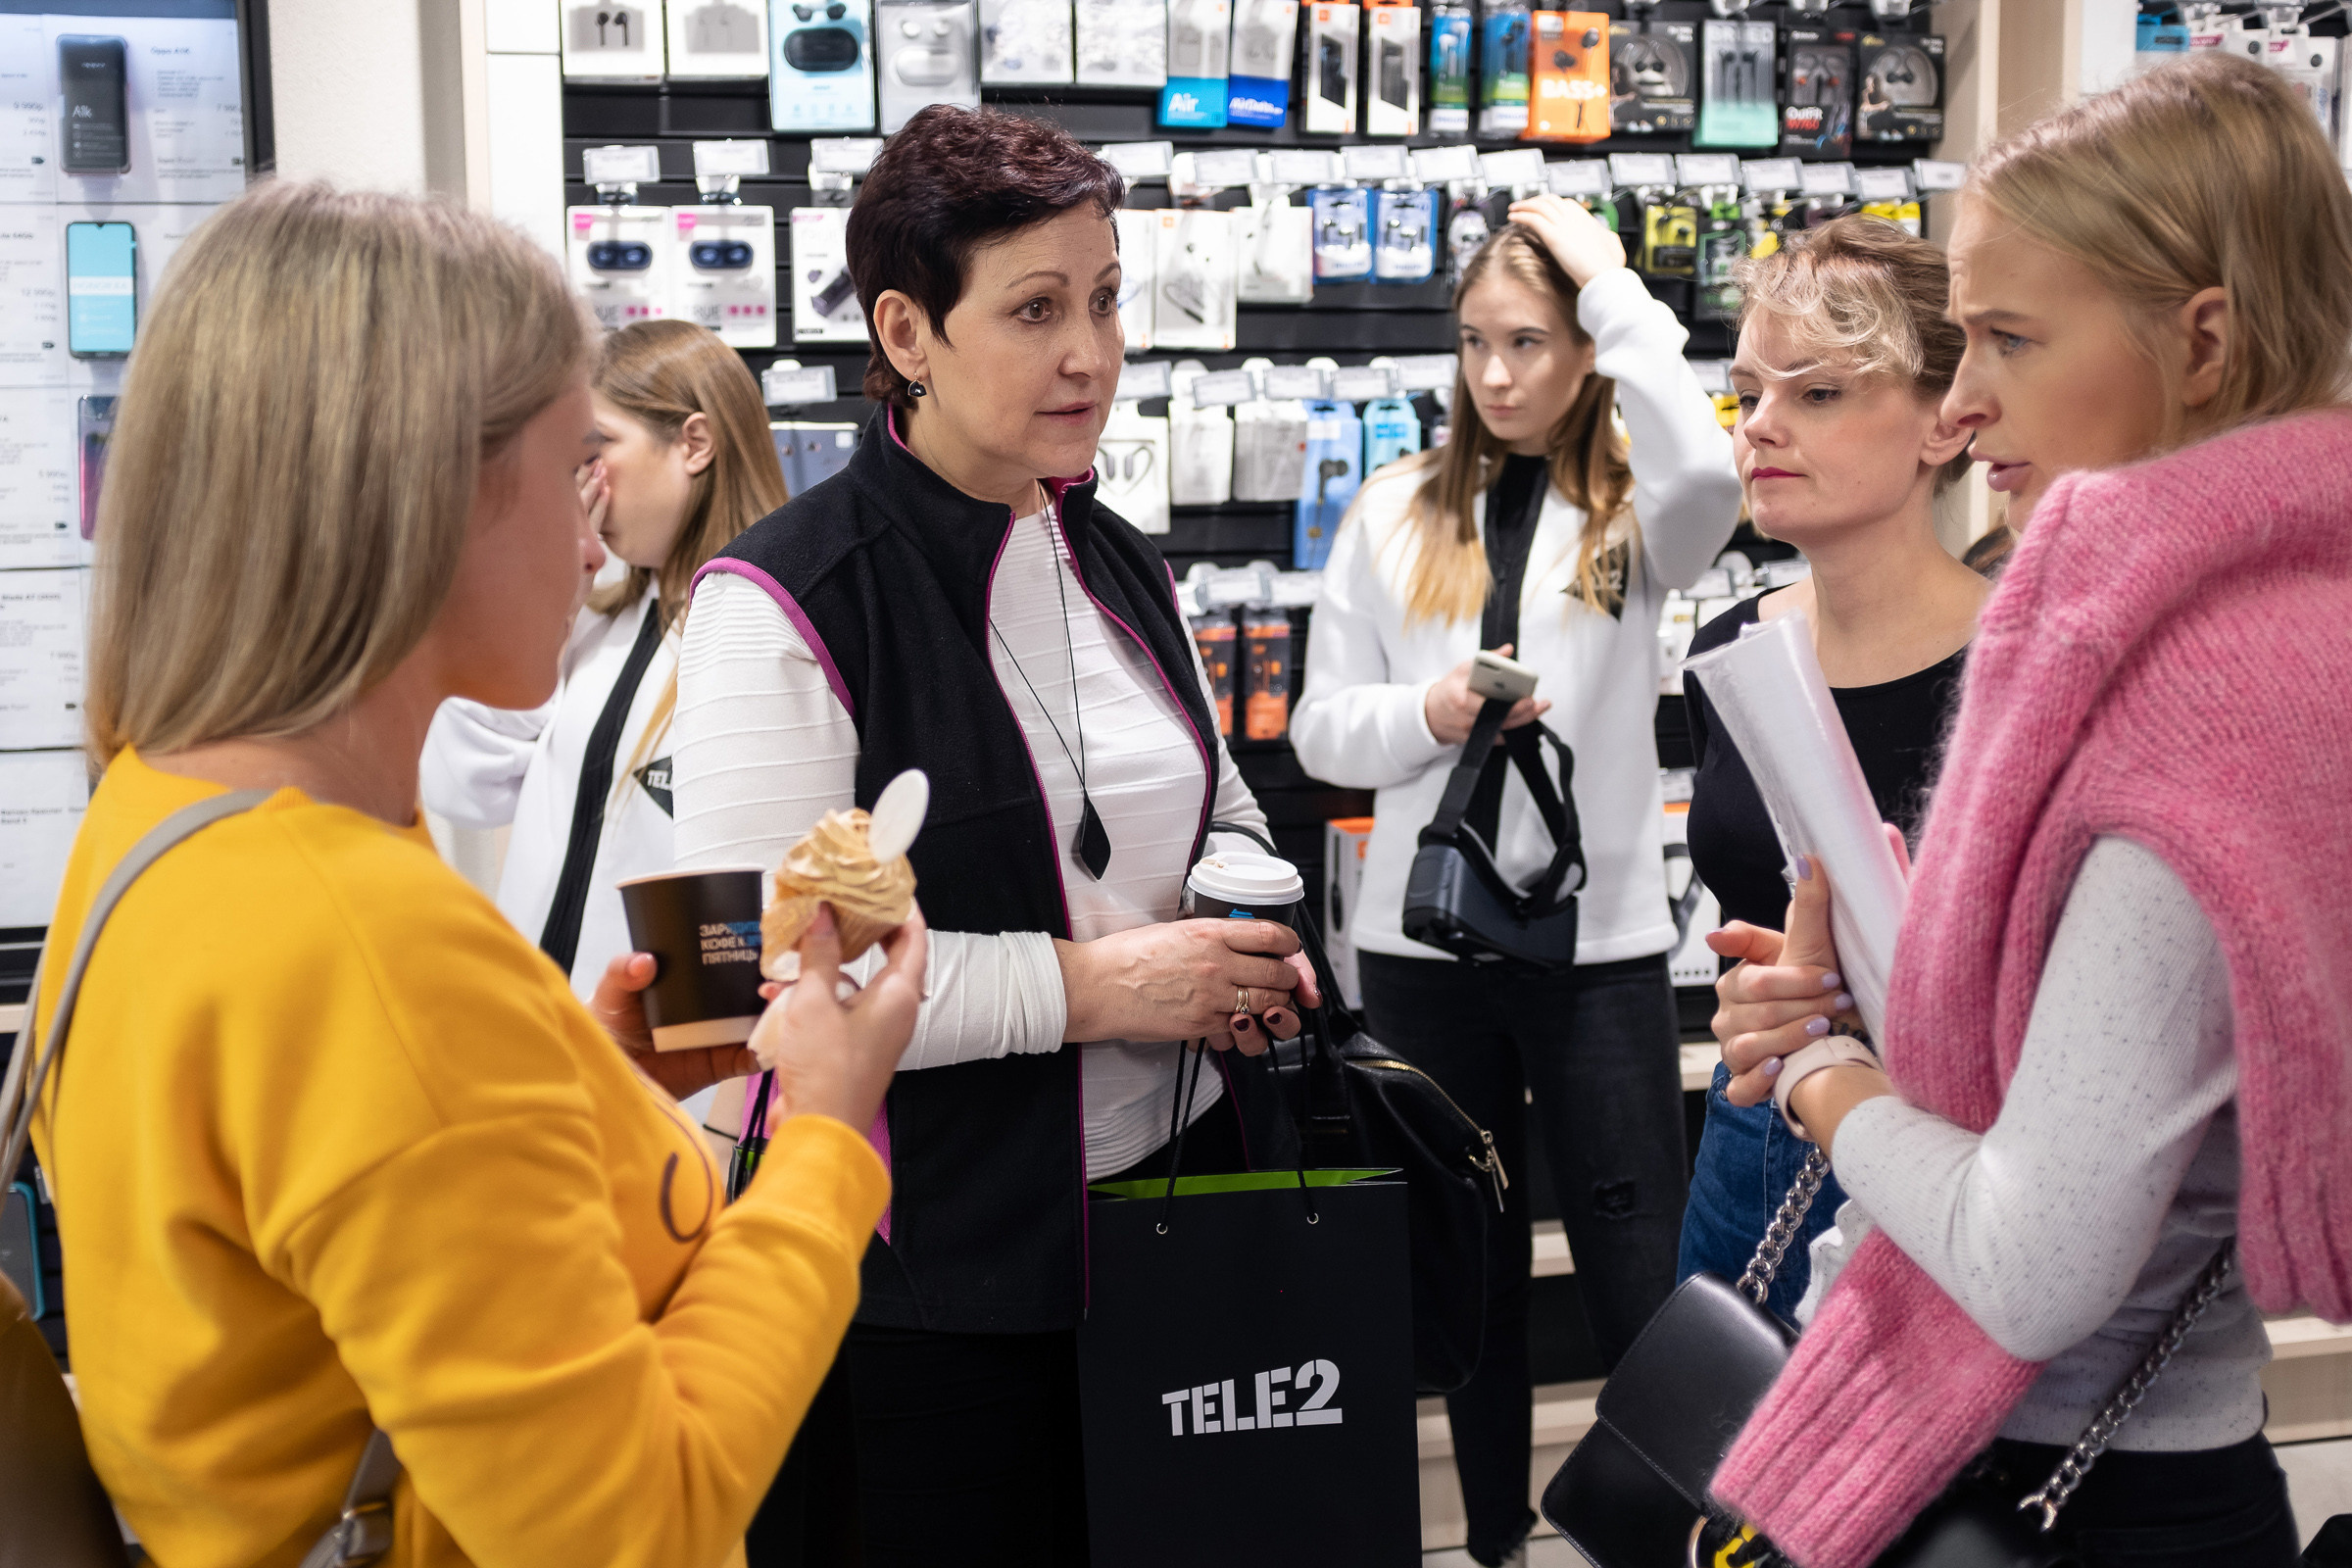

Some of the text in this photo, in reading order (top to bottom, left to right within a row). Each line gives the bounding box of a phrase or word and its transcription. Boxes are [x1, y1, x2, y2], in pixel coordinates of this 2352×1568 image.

[1542, 79, 1607, 99] BASS+
[1167, 92, 1199, 112] Air
[700, 936, 737, 951] КОФЕ
[1161, 1358, 1344, 1437] TELE2
